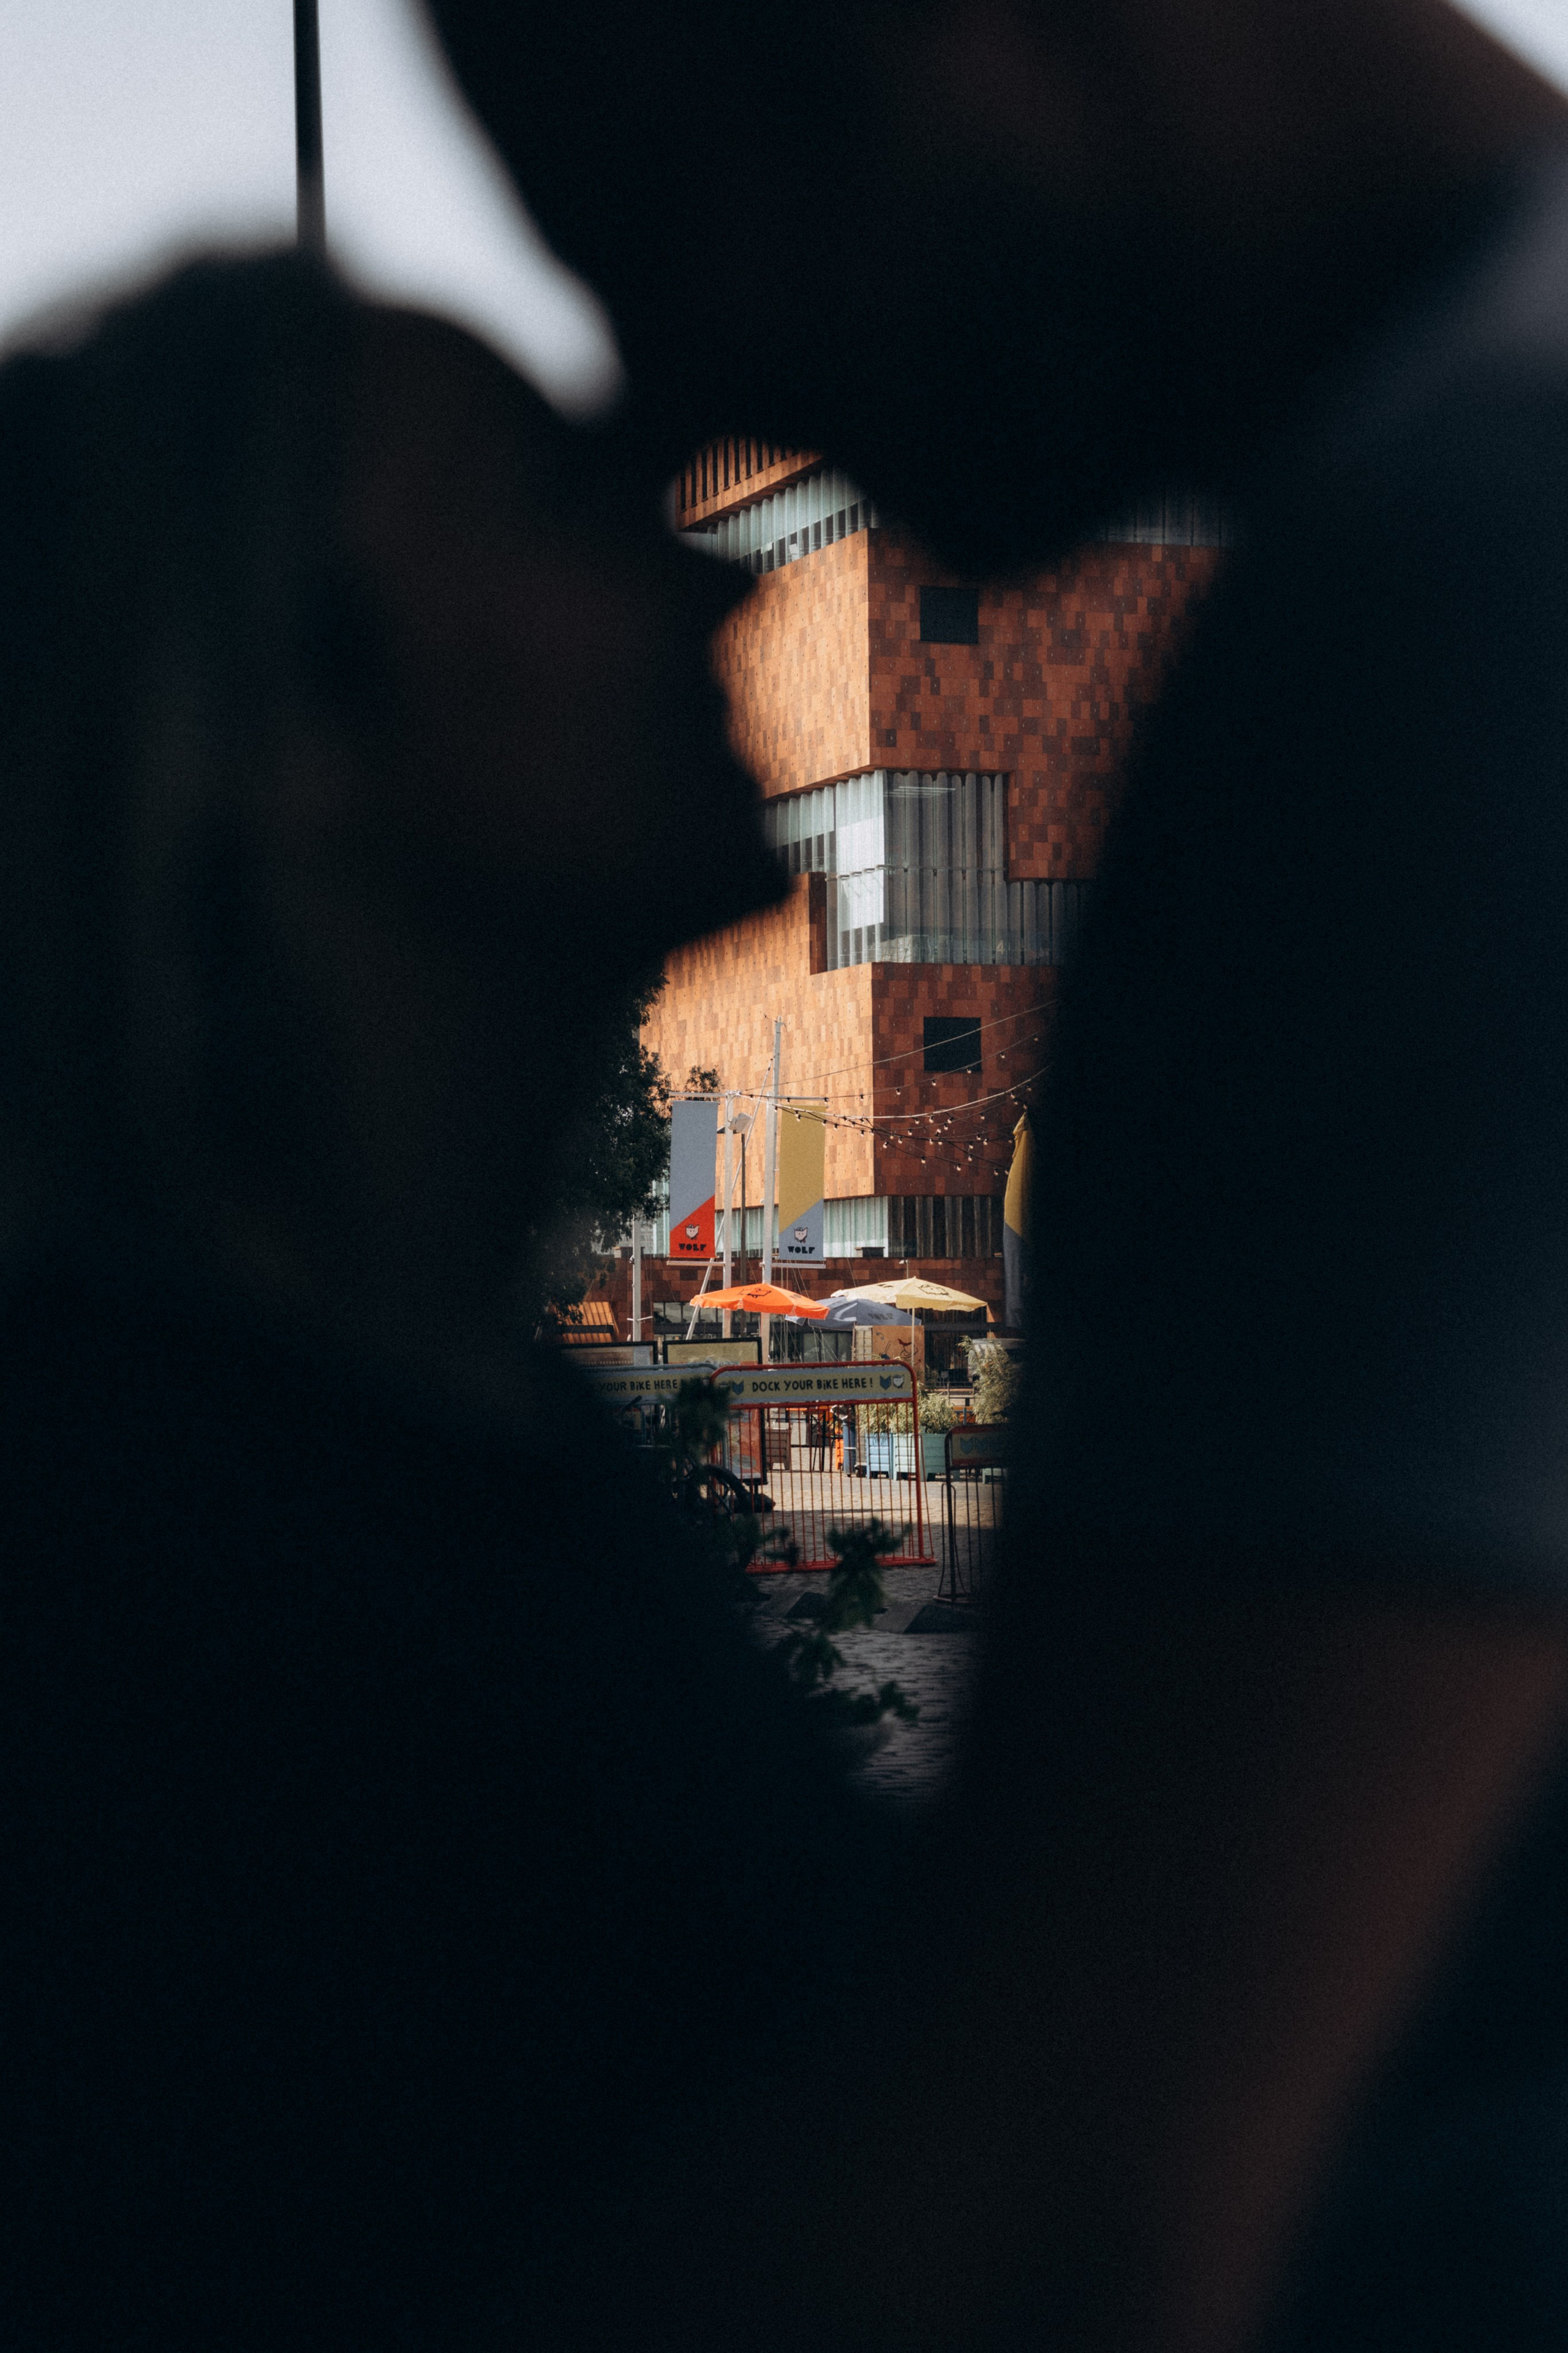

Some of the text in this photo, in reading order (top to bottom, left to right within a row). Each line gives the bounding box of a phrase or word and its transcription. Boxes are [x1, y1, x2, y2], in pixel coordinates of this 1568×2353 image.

[600, 1381, 627, 1392] YOUR
[654, 1379, 677, 1390] HERE
[752, 1381, 780, 1392] DOCK
[784, 1380, 813, 1391] YOUR
[842, 1378, 867, 1389] HERE
